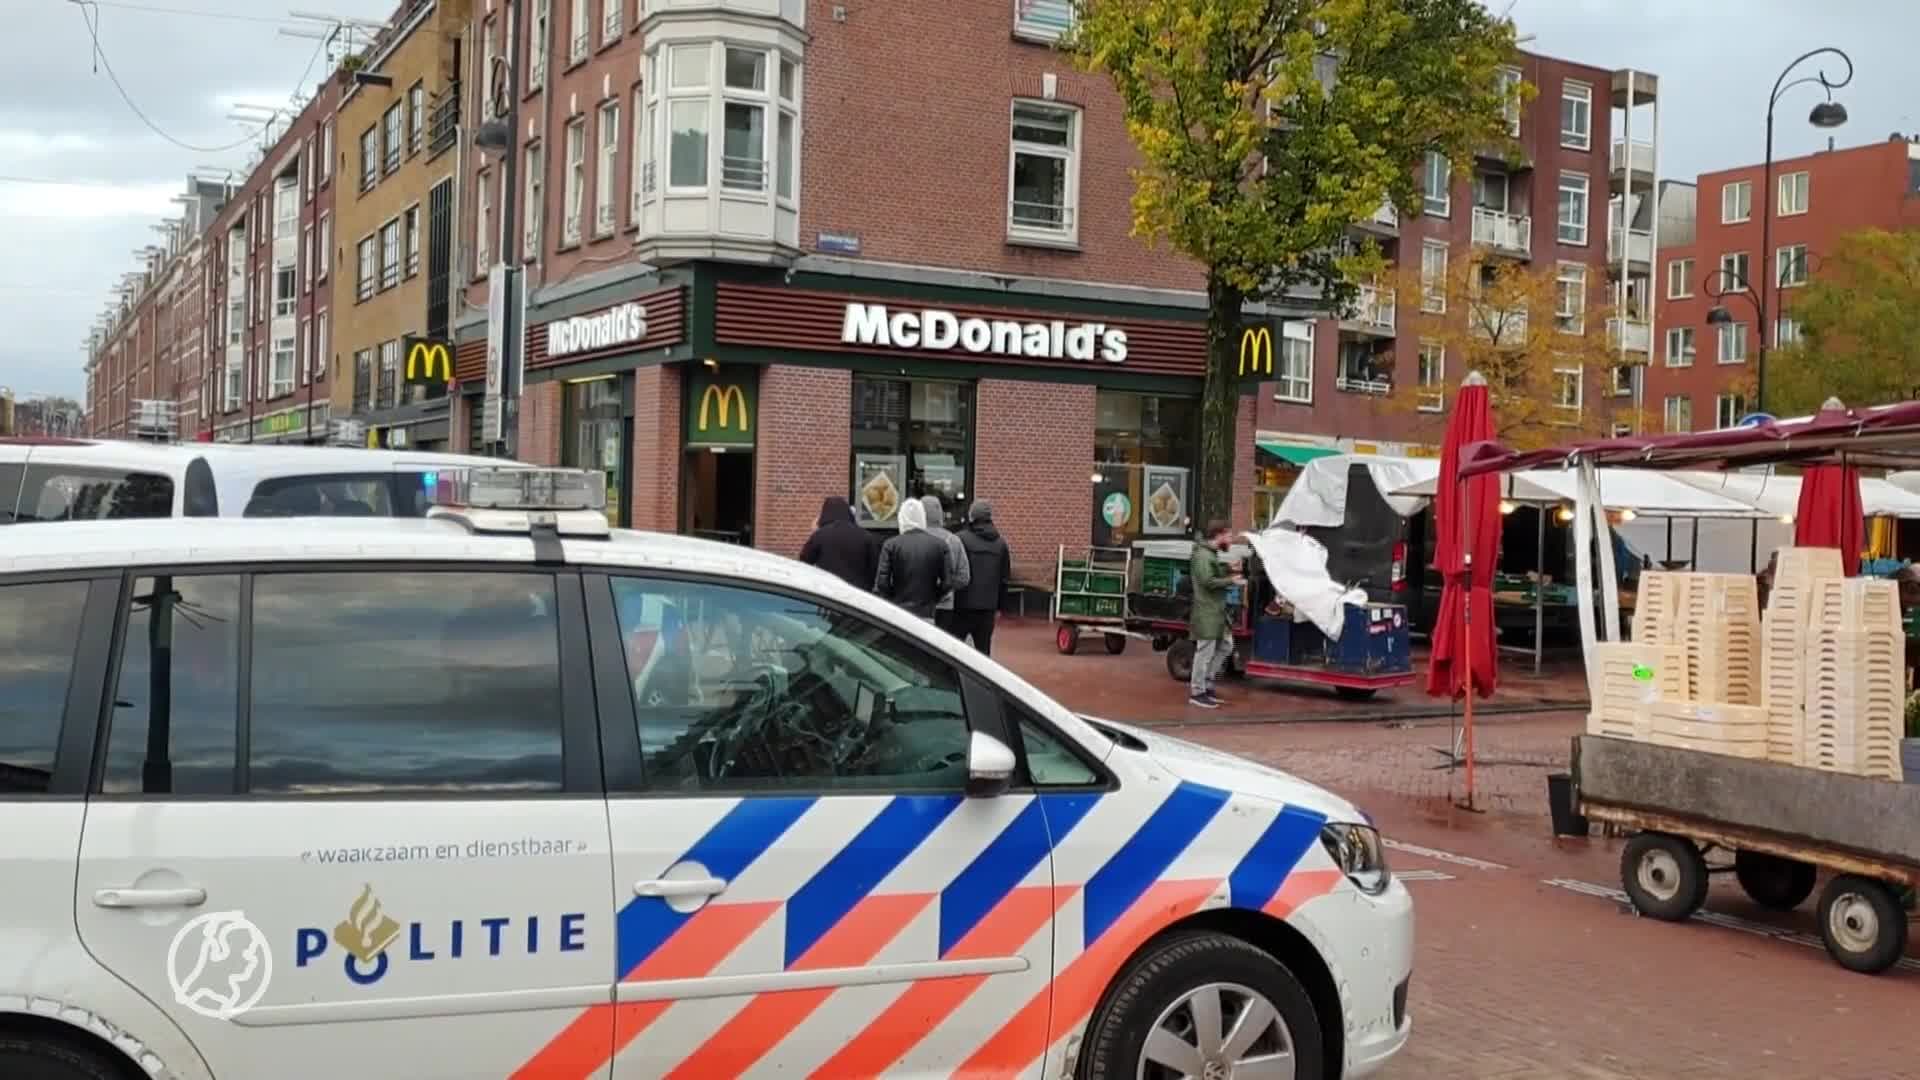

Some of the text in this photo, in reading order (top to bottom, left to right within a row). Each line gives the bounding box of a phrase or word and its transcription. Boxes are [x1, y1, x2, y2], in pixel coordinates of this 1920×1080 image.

[547, 302, 648, 356] McDonald's
[841, 303, 1129, 363] McDonald's
[318, 844, 429, 864] waakzaam
[435, 845, 459, 860] en
[466, 837, 573, 857] dienstbaar
[296, 913, 586, 985] POLITIE
